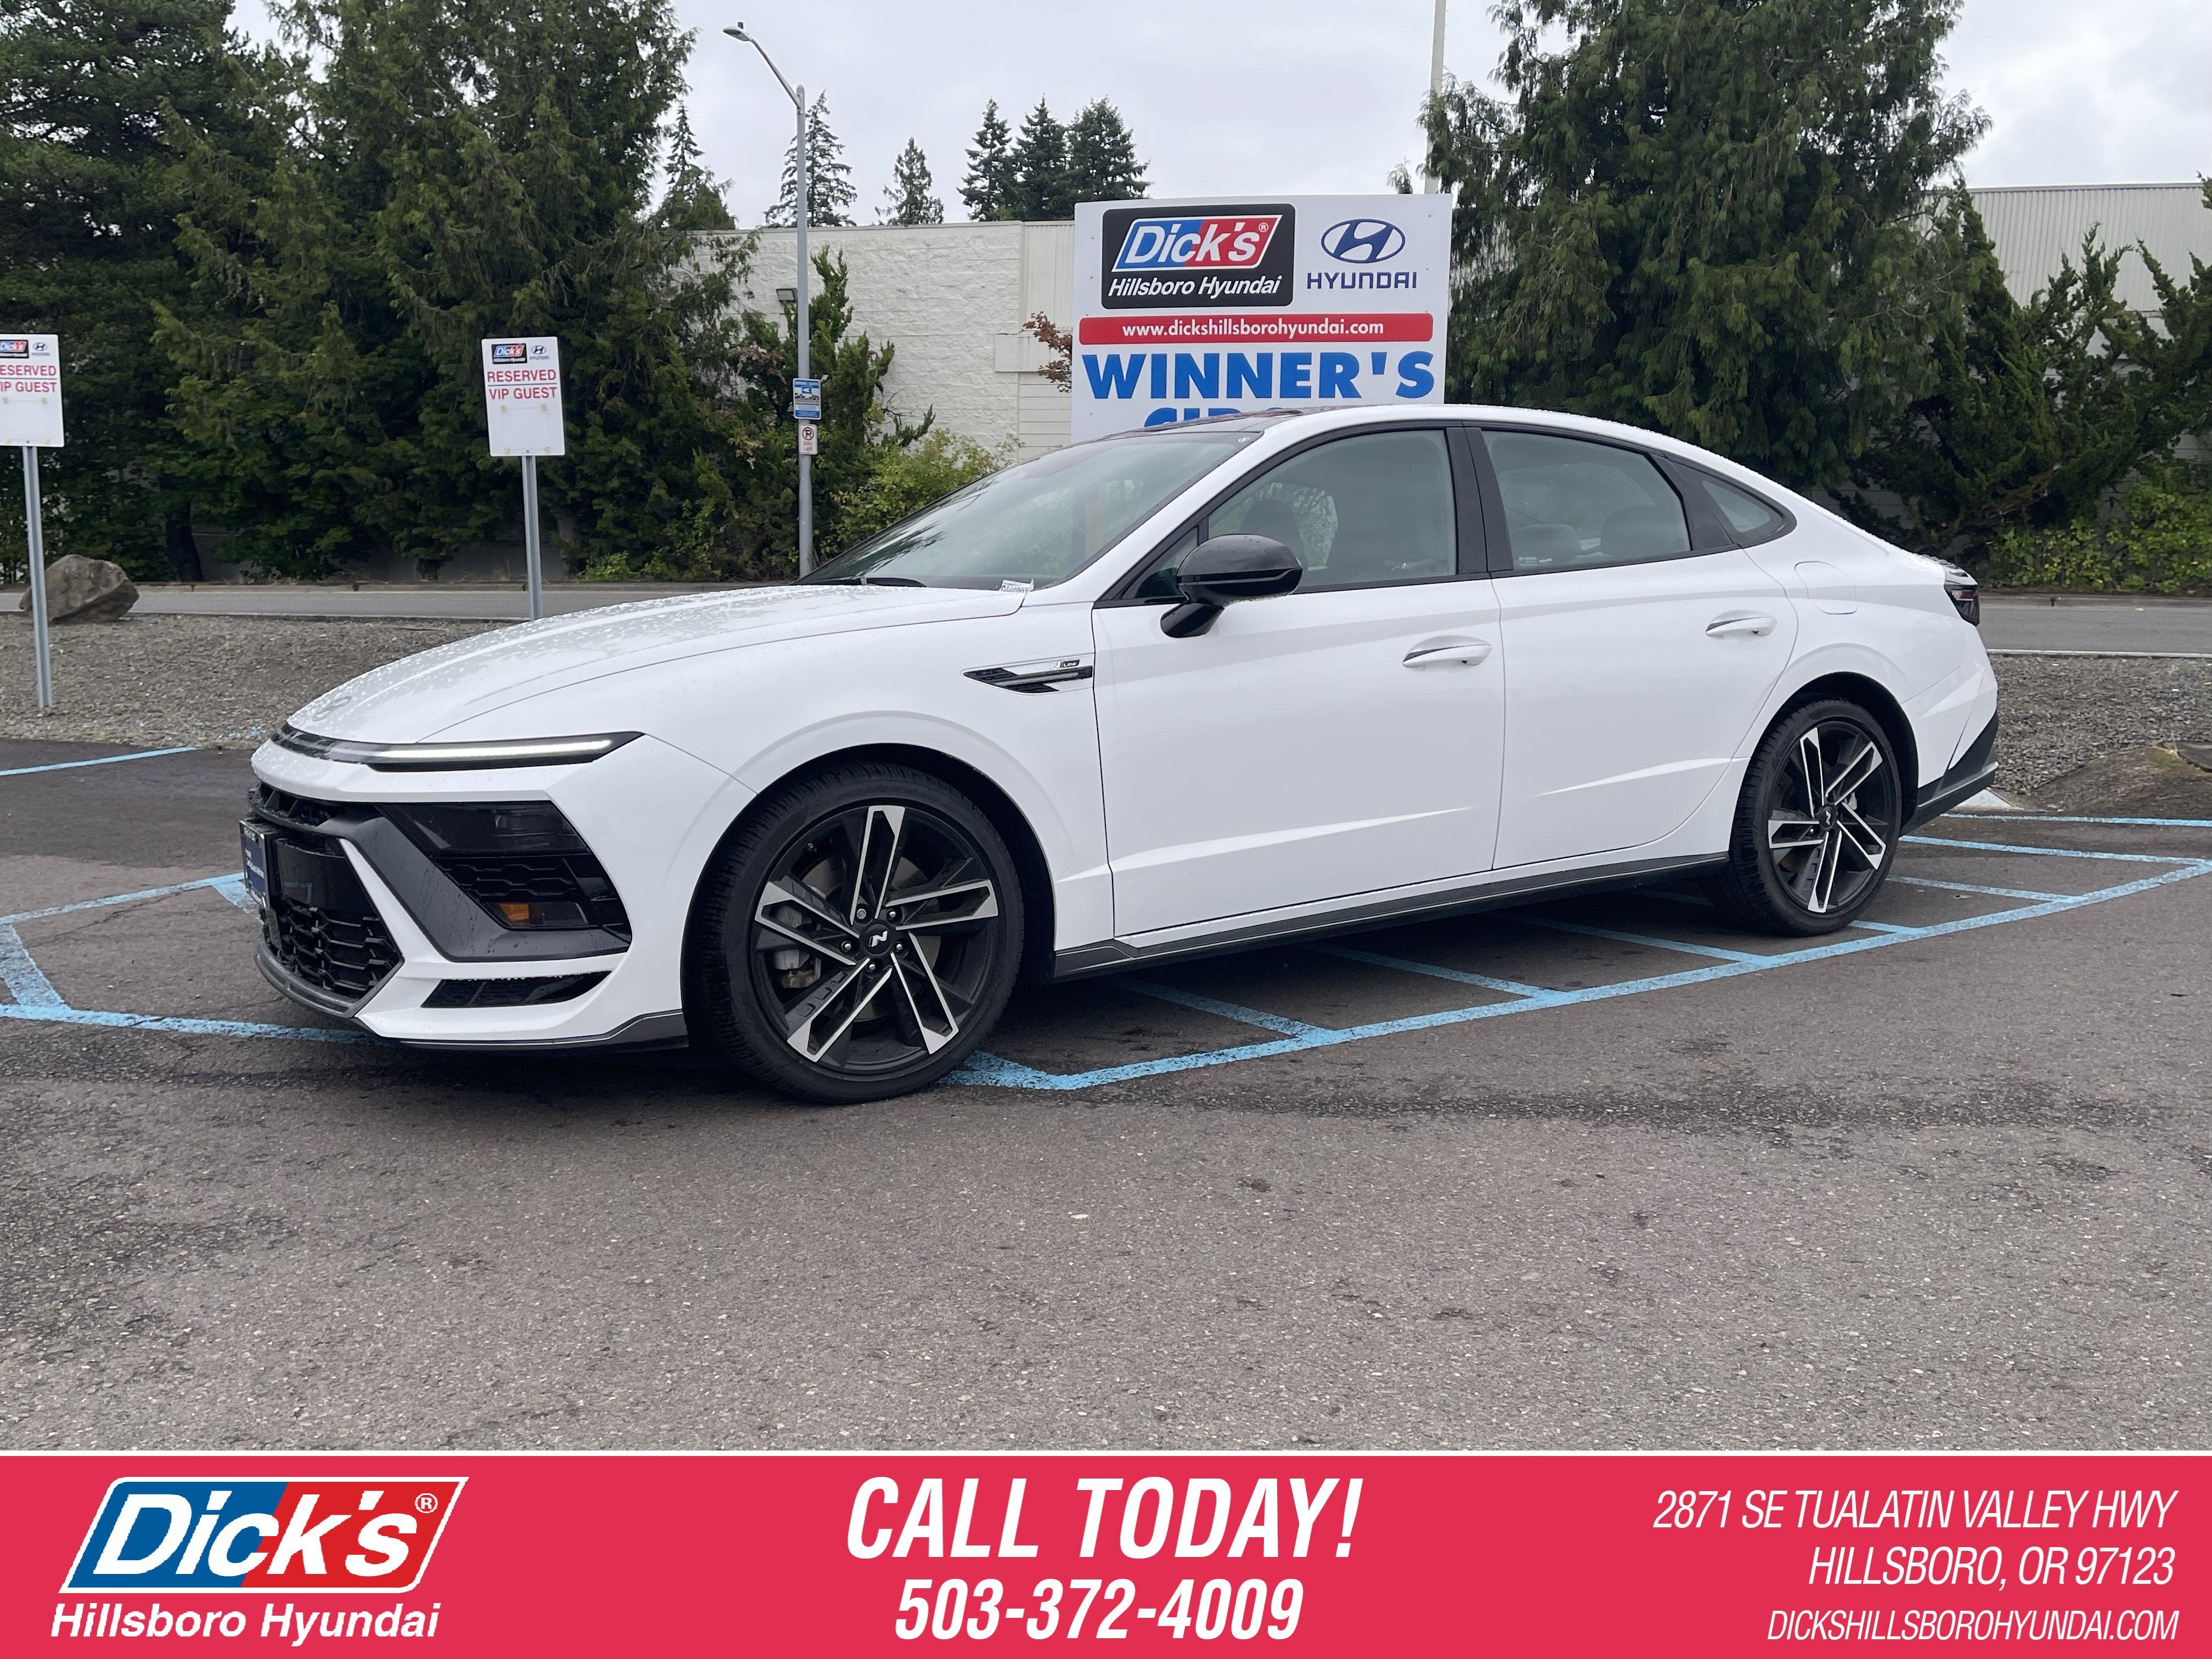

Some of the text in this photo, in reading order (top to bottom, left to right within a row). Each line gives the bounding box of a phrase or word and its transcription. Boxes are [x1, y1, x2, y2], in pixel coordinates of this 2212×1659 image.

[1108, 275, 1282, 299] Hillsboro Hyundai
[1307, 272, 1417, 289] HYUNDAI
[1122, 319, 1384, 340] www.dickshillsborohyundai.com
[0, 365, 57, 376] ESERVED
[487, 370, 556, 382] RESERVED
[1081, 351, 1435, 399] WINNER'S
[0, 381, 57, 393] IP GUEST
[489, 387, 556, 399] VIP GUEST
